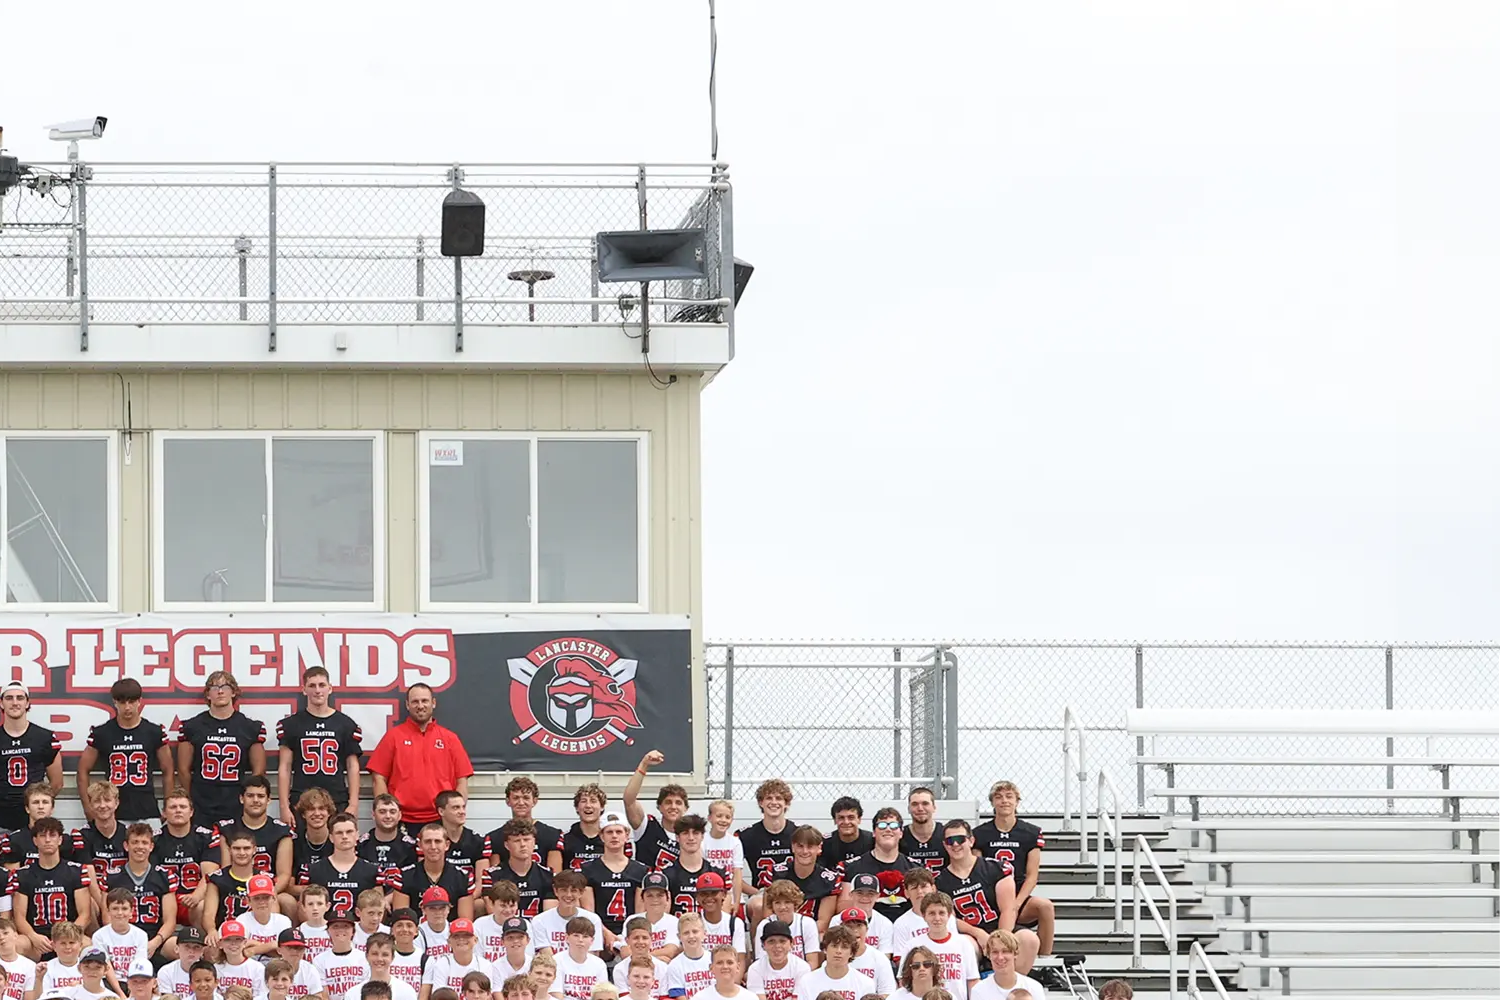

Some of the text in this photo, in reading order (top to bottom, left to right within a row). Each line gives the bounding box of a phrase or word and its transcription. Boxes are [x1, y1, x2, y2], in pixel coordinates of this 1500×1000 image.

[66, 628, 456, 692] LEGENDS
[535, 640, 610, 661] LANCASTER
[541, 734, 607, 752] LEGENDS
[201, 743, 241, 781] 62
[301, 738, 339, 775] 56
[7, 756, 27, 786] 0
[109, 751, 148, 786] 83
[707, 850, 733, 859] EGENDS
[952, 883, 982, 896] LANCASTER
[34, 893, 68, 926] 10
[333, 890, 353, 911] 2
[607, 889, 626, 921] 4
[953, 890, 999, 926] 51
[937, 954, 961, 963] GENDS
[325, 968, 363, 976] LEGENDS
[389, 967, 422, 976] EGENDS
[939, 969, 961, 980] KING
